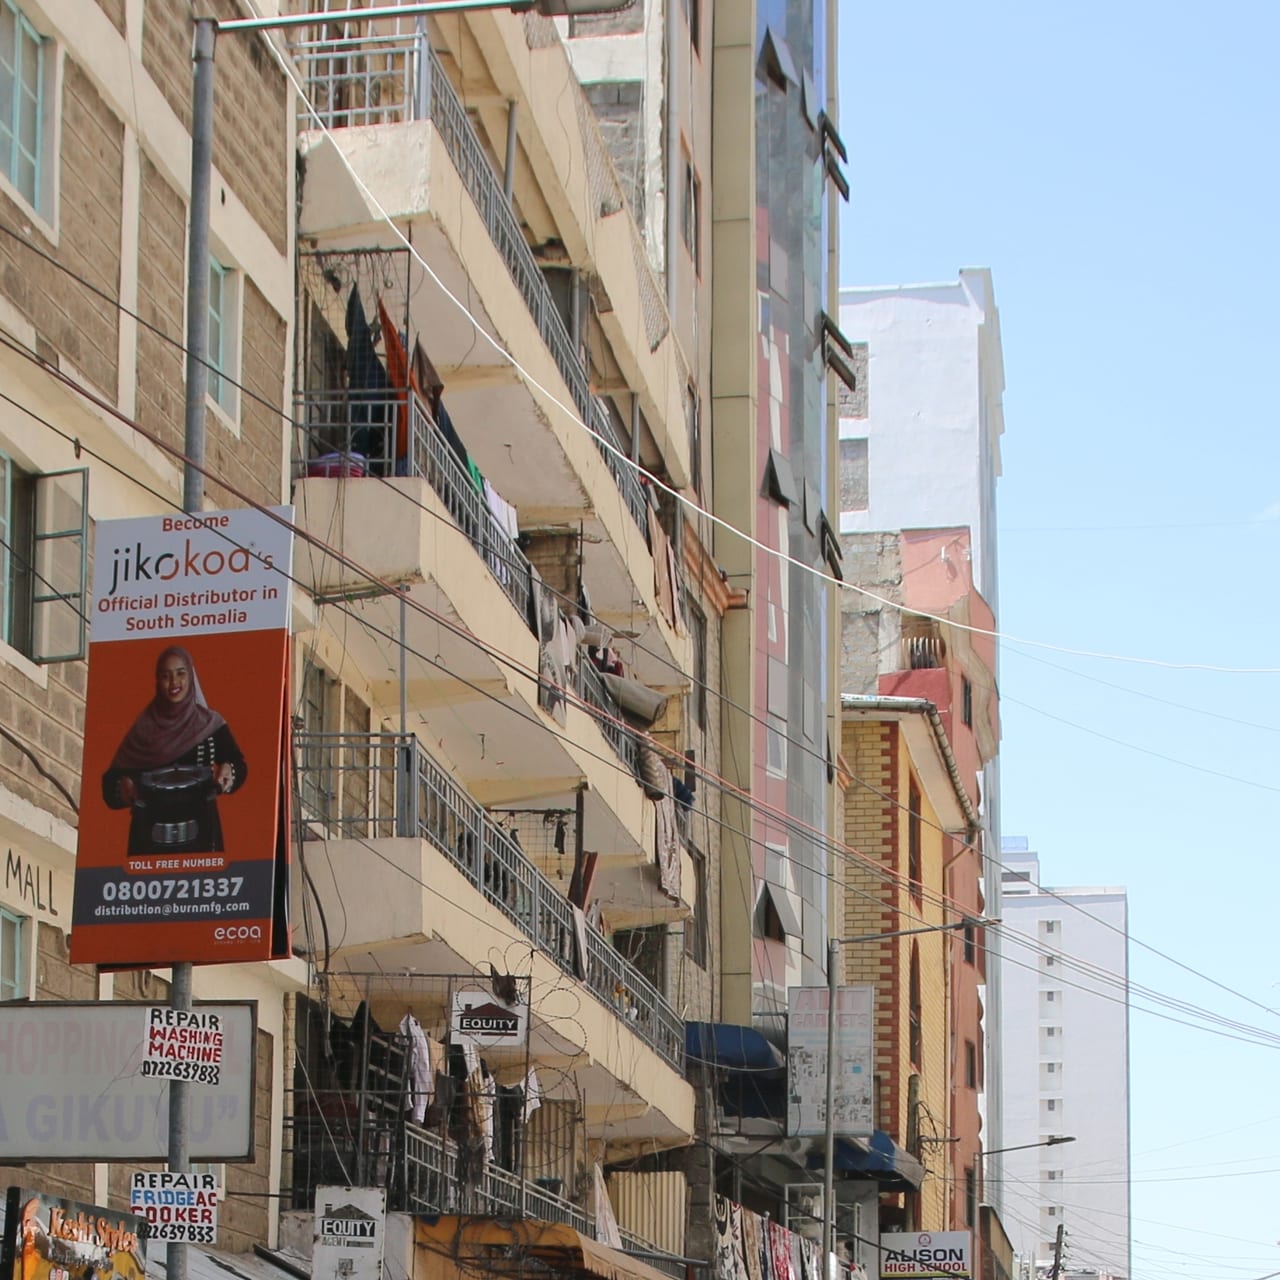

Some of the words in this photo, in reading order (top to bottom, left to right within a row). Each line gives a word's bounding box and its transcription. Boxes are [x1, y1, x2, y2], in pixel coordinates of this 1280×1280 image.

[162, 515, 230, 532] Become
[98, 593, 158, 613] Official
[163, 587, 257, 608] Distributor
[262, 585, 278, 600] in
[125, 613, 175, 631] South
[180, 609, 248, 627] Somalia
[128, 861, 153, 870] TOLL
[155, 860, 180, 869] FREE
[182, 857, 224, 868] NUMBER
[5, 847, 59, 916] MALL
[102, 876, 244, 901] 0800721337
[94, 901, 250, 916] distribution@burnmfg.com
[214, 925, 262, 940] ecoa
[150, 1008, 220, 1030] REPAIR
[462, 1018, 515, 1029] EQUITY
[148, 1025, 224, 1047] WASHING
[147, 1041, 223, 1064] MACHINE
[140, 1060, 220, 1086] 0722639833
[133, 1173, 215, 1190] REPAIR
[323, 1220, 374, 1237] EQUITY
[884, 1248, 964, 1262] ALISON
[884, 1263, 916, 1273] HIGH
[919, 1262, 968, 1272] SCHOOL
